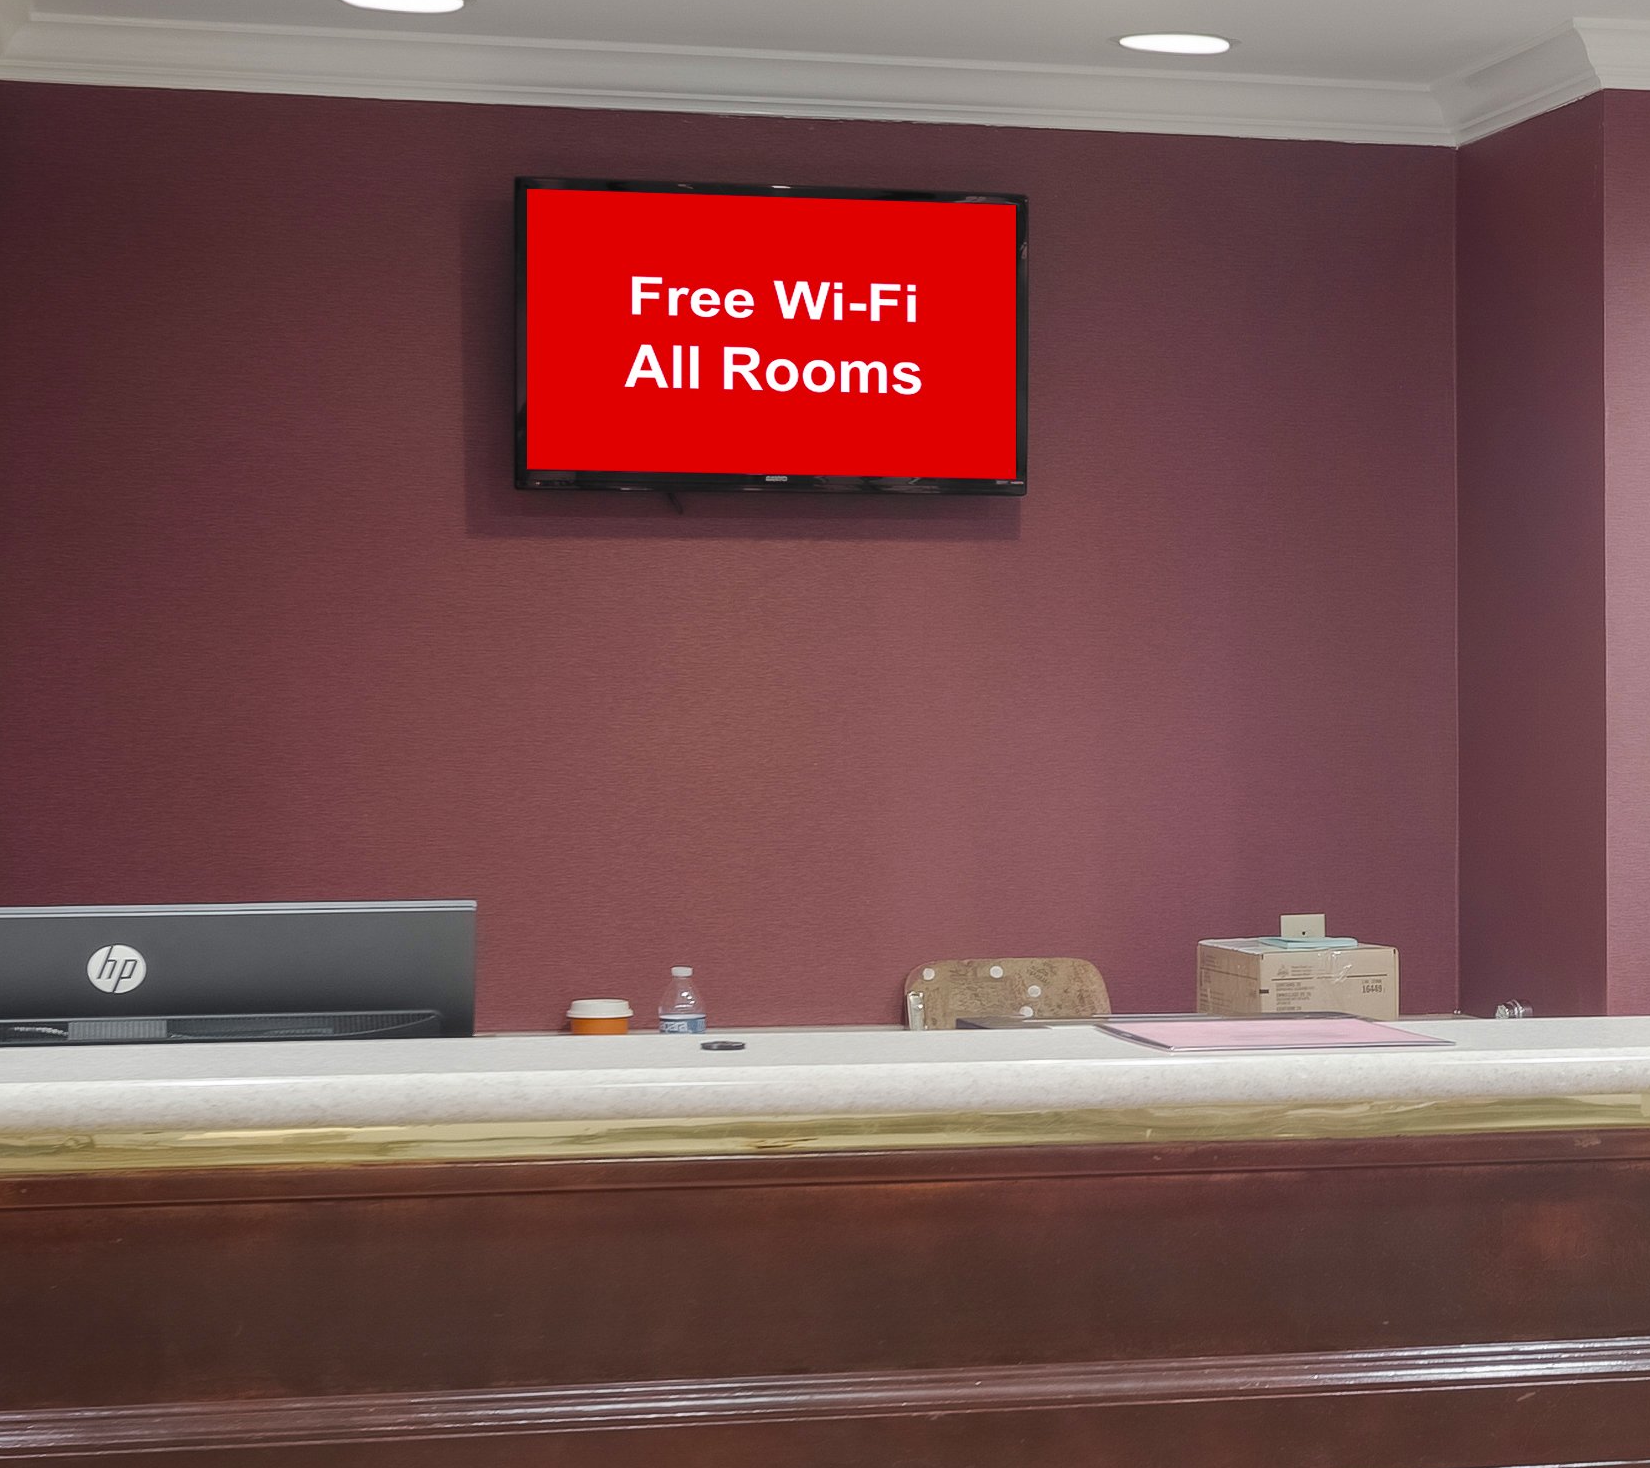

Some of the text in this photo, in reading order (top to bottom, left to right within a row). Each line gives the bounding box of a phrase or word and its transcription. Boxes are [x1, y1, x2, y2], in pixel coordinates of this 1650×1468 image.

[631, 275, 917, 323] Free Wi-Fi
[624, 344, 922, 396] All Rooms
[92, 944, 142, 994] hp
